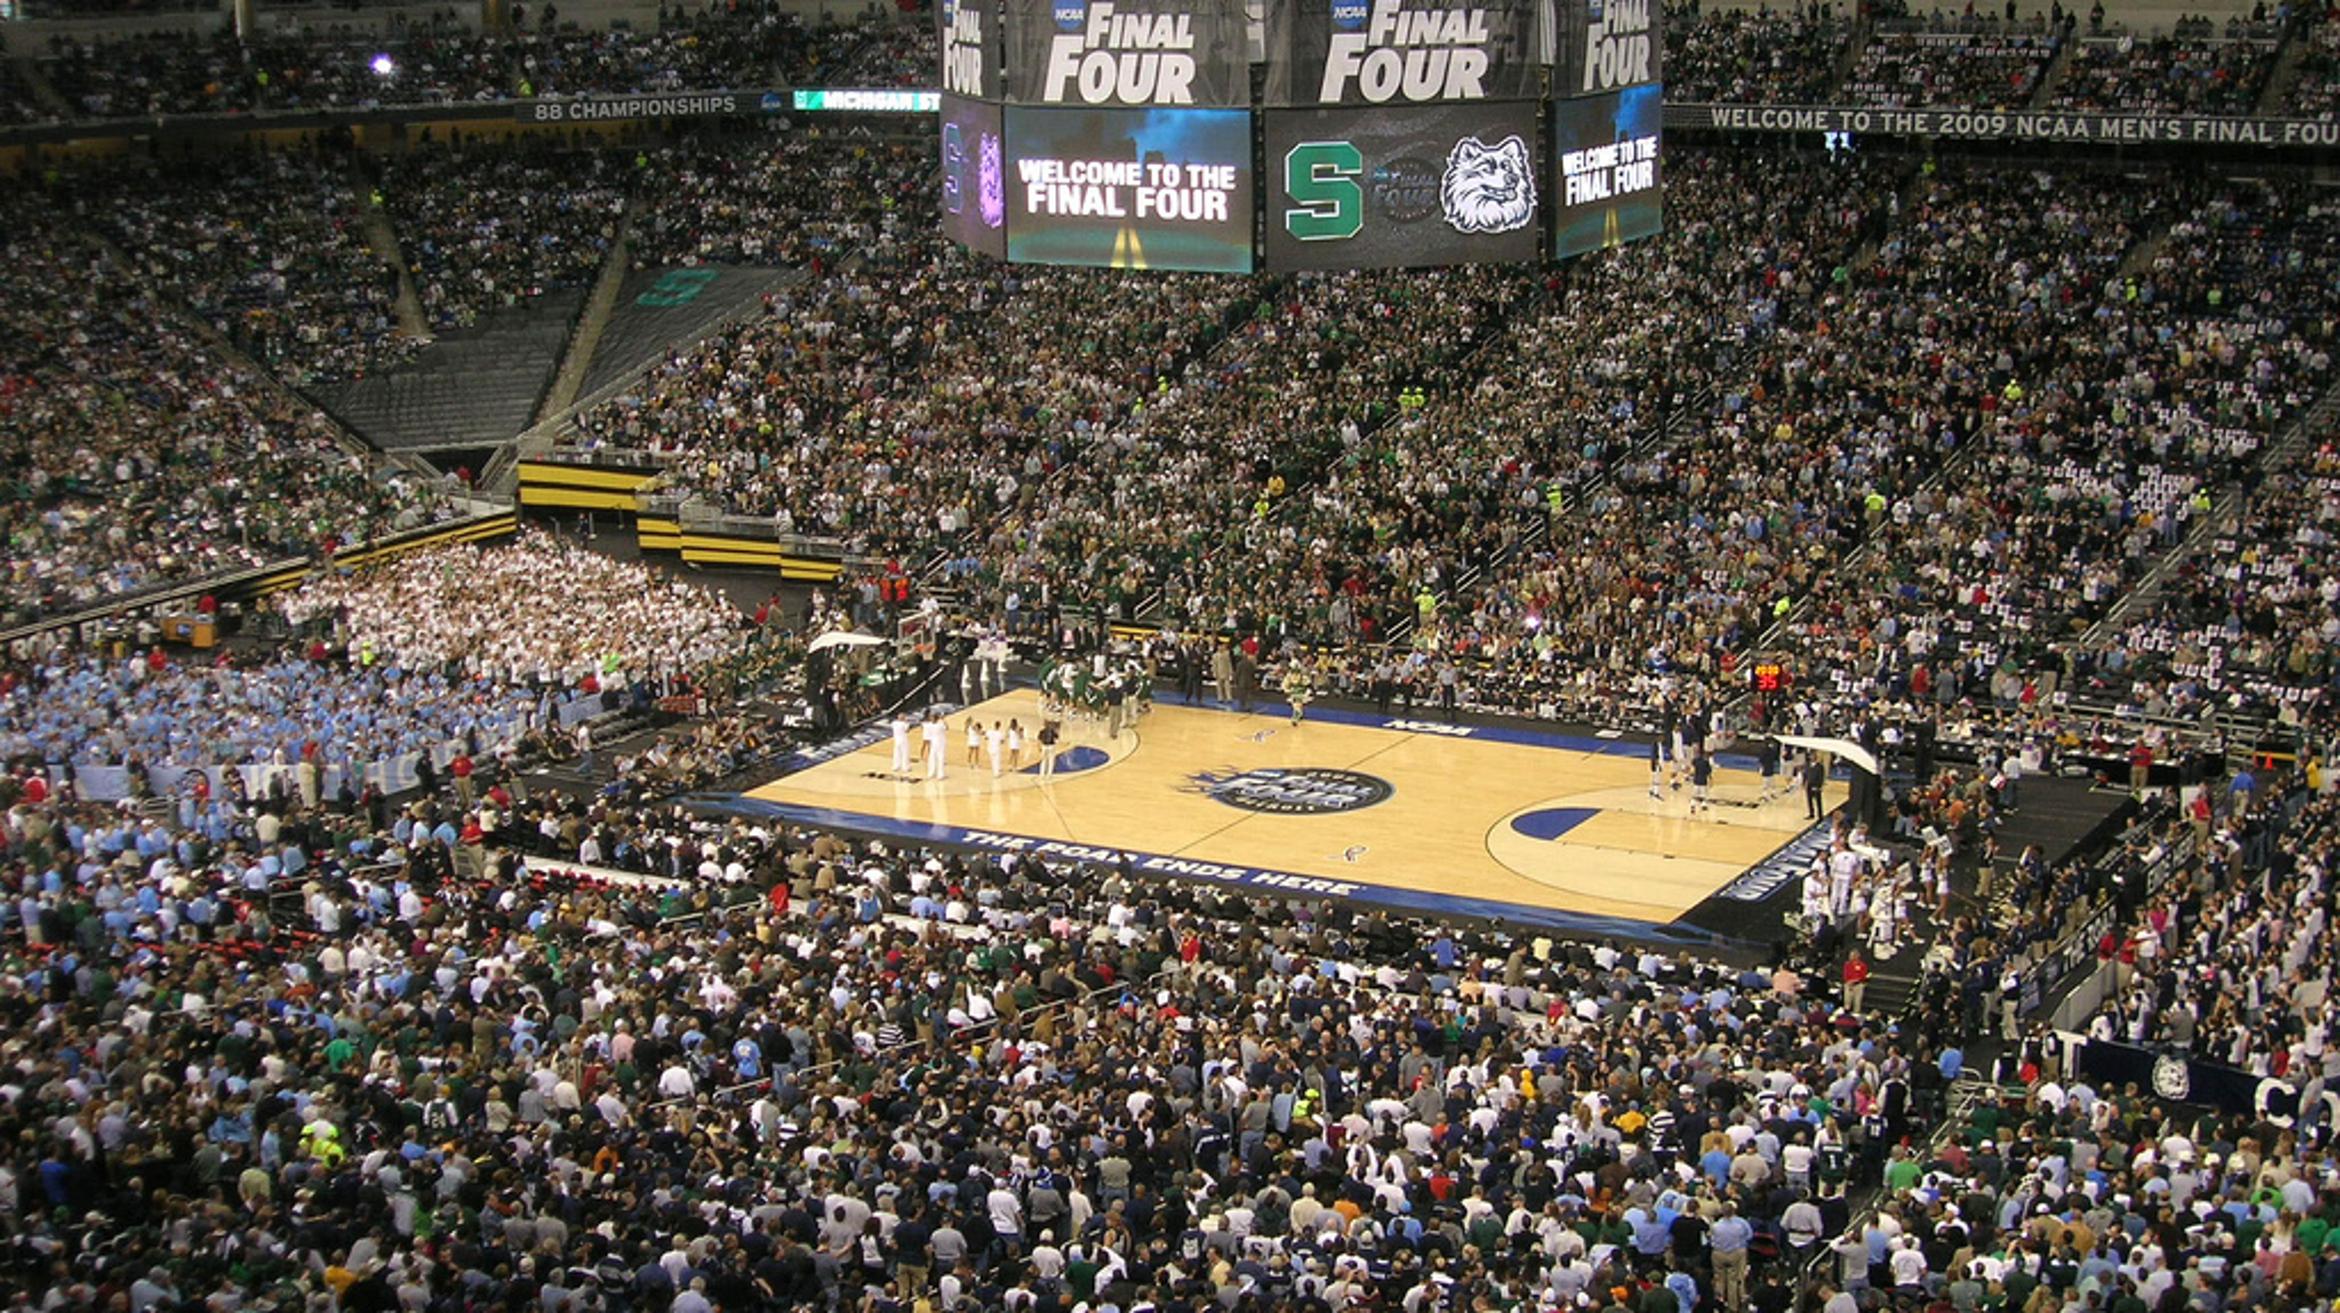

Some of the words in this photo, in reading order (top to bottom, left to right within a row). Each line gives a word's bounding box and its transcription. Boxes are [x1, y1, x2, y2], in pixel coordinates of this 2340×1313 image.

[1055, 8, 1084, 21] NCAA
[1085, 2, 1195, 49] FINAL
[1334, 5, 1367, 19] NCAA
[1368, 0, 1489, 46] FINAL
[1602, 0, 1650, 34] FINAL
[943, 27, 983, 97] FOUR
[1044, 35, 1196, 103] FOUR
[1319, 33, 1489, 103] FOUR
[1583, 23, 1651, 91] FOUR
[534, 103, 563, 121] 88
[569, 97, 737, 120] CHAMPIONSHIPS
[1711, 108, 1830, 131] WELCOME
[1839, 110, 1871, 131] TO
[1880, 112, 1930, 132] THE
[1938, 113, 2007, 134] 2009
[2016, 115, 2090, 138] NCAA
[2100, 117, 2182, 140] MEN'S
[2193, 119, 2273, 143] FINAL
[1018, 159, 1142, 186] WELCOME
[1147, 163, 1181, 187] TO
[1188, 165, 1236, 190] THE
[1562, 142, 1618, 176] WELCOME
[1620, 140, 1635, 164] TO
[1636, 136, 1657, 161] THE
[1027, 183, 1126, 217] FINAL
[1135, 187, 1229, 221] FOUR
[1284, 140, 1364, 241] S
[1566, 168, 1612, 207] FINAL
[1614, 160, 1653, 195] FOUR
[1759, 675, 1778, 691] 35
[963, 831, 1034, 850] THE
[1142, 857, 1248, 880] ENDS
[1251, 872, 1360, 897] HERE
